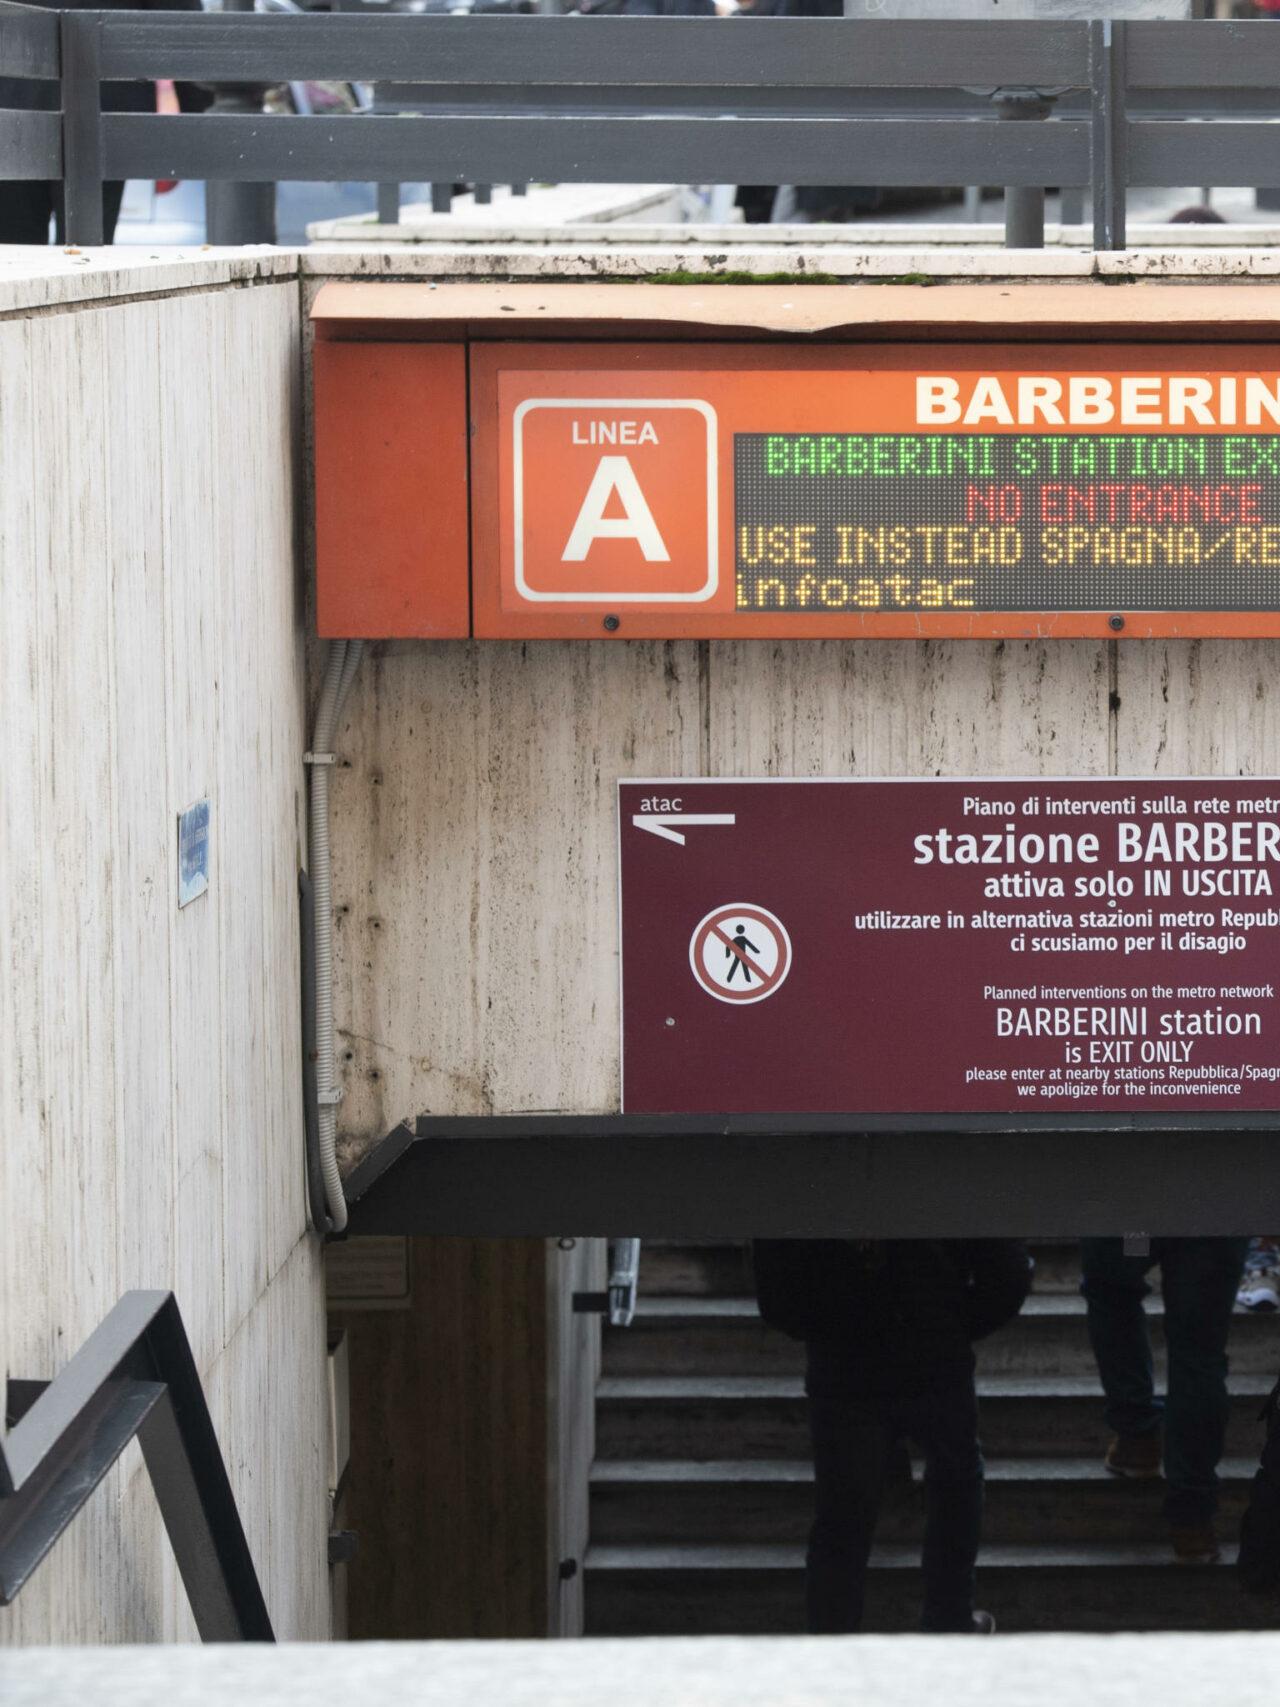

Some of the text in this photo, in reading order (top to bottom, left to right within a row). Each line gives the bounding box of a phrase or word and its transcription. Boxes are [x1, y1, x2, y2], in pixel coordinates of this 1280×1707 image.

[572, 421, 660, 445] LINEA
[767, 436, 995, 475] BARBERINI
[1014, 436, 1206, 475] STATION
[561, 456, 671, 562] A
[966, 484, 1263, 523] NO ENTRANCE
[740, 526, 816, 565] USE
[836, 526, 1022, 565] INSTEAD
[736, 573, 975, 607] infoatac
[640, 796, 682, 812] atac
[963, 796, 1016, 816] Piano
[1021, 796, 1040, 816] di
[1045, 796, 1136, 816] interventi
[1142, 796, 1188, 815] sulla
[1193, 797, 1231, 814] rete
[913, 823, 1100, 865] stazione
[983, 869, 1273, 898] attiva solo IN USCITA
[854, 910, 941, 930] utilizzare
[947, 910, 965, 929] in
[970, 909, 1074, 929] alternativa
[1079, 908, 1153, 928] stazioni
[1159, 910, 1215, 928] metro
[1010, 931, 1247, 955] ci scusiamo per il disagio
[984, 983, 1274, 1000] Planned interventions on the metro network
[997, 1005, 1262, 1037] BARBERINI station
[1065, 1040, 1194, 1064] is EXIT ONLY
[965, 1066, 1008, 1083] please
[1011, 1067, 1046, 1080] enter
[1048, 1067, 1062, 1080] at
[1065, 1065, 1110, 1083] nearby
[1114, 1065, 1165, 1080] stations
[1017, 1080, 1242, 1099] we apoligize for the inconvenience
